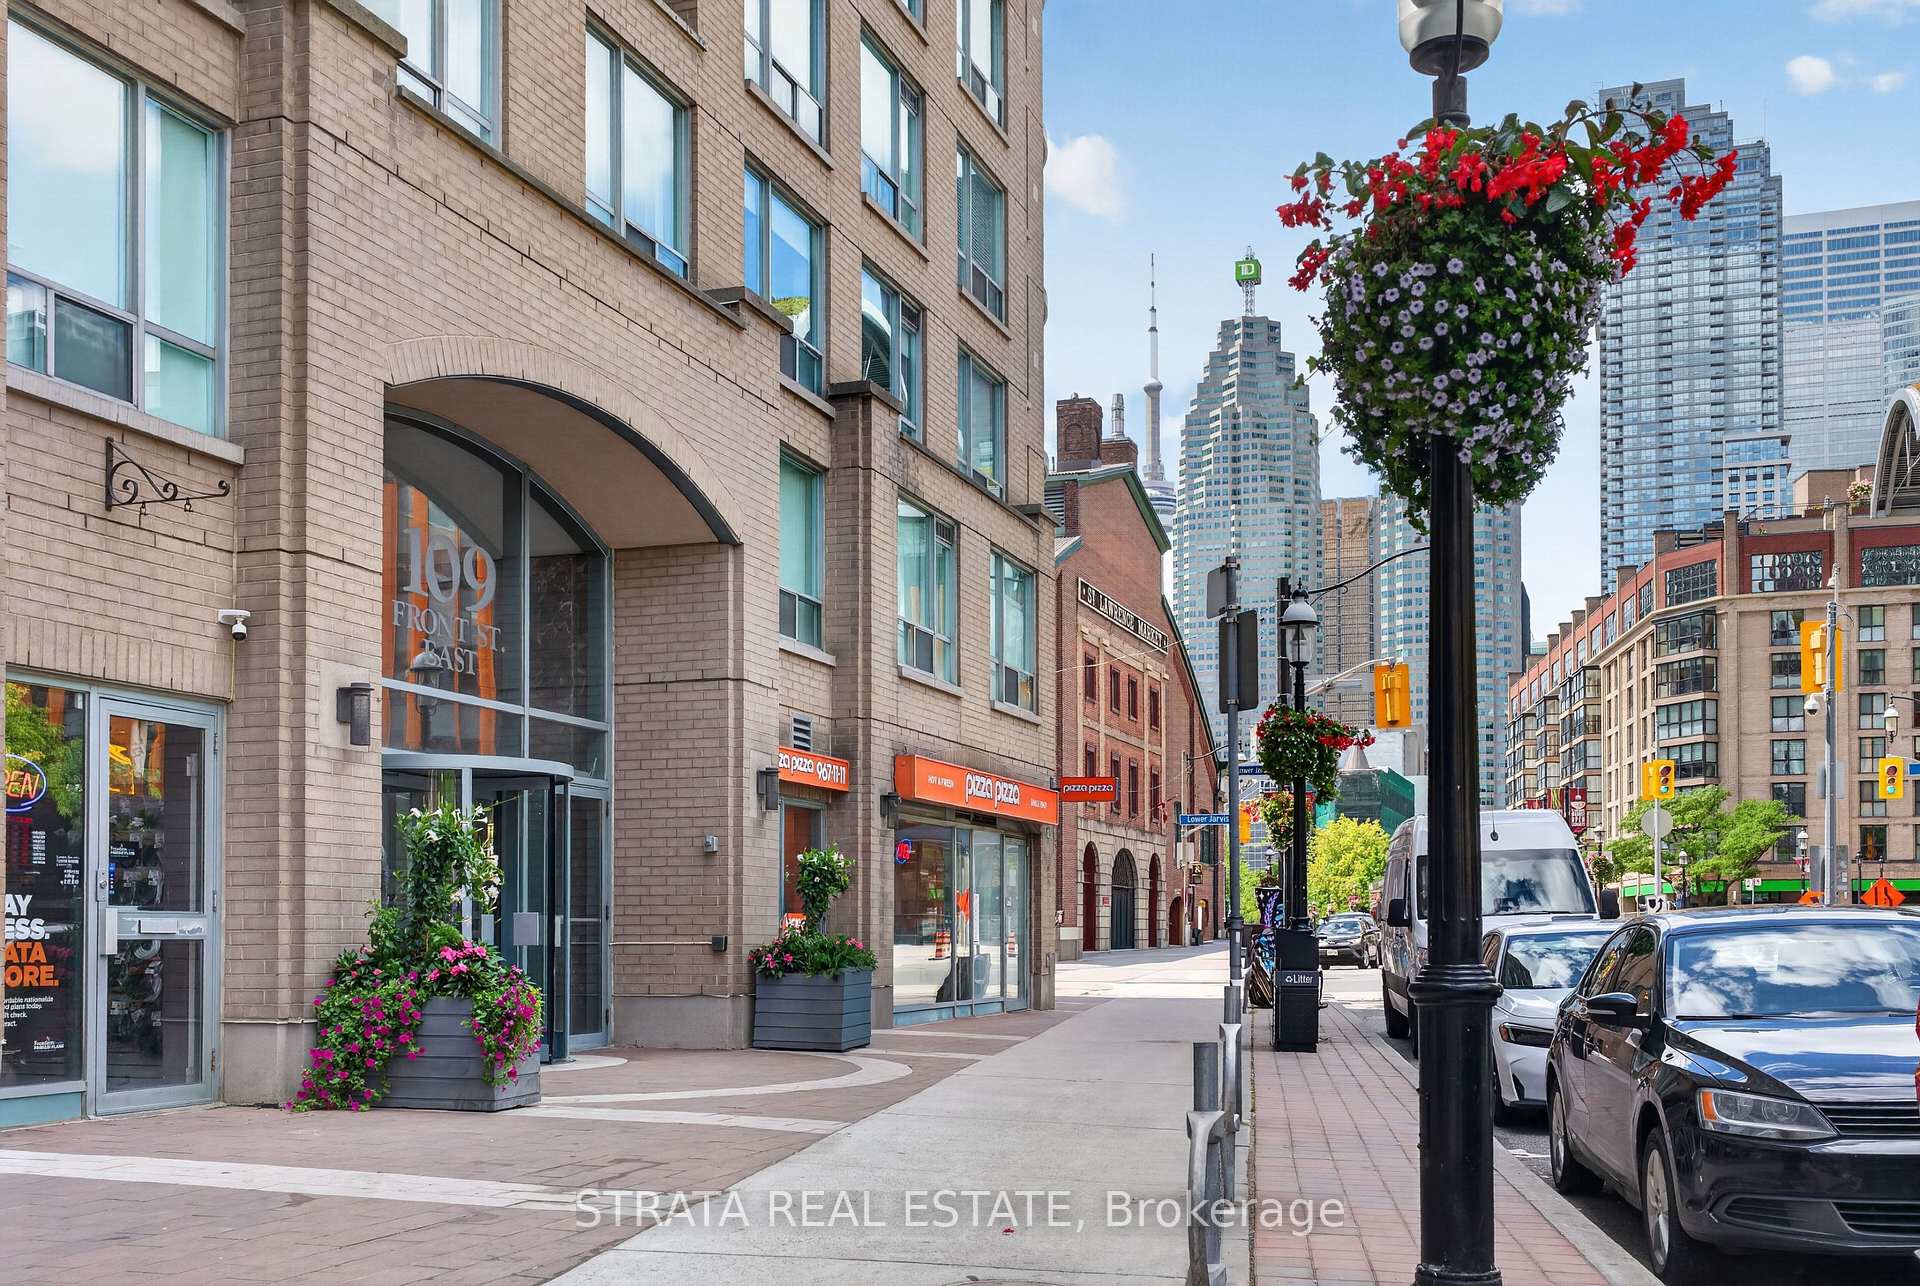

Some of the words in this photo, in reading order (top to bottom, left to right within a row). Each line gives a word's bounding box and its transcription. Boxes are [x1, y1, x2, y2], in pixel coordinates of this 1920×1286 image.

[1238, 263, 1255, 276] TD
[403, 527, 497, 612] 109
[392, 600, 470, 644] FRONT
[476, 622, 506, 654] ST.
[1099, 594, 1135, 631] LAWRENCE
[1137, 619, 1163, 648] MARKET
[791, 755, 814, 774] pizza
[965, 772, 993, 804] pizza
[994, 780, 1020, 809] pizza
[1063, 784, 1087, 794] pizza
[1088, 784, 1113, 794] pizza
[1187, 815, 1208, 823] Lower
[1209, 815, 1229, 823] Jarvis
[1293, 974, 1313, 984] Litter
